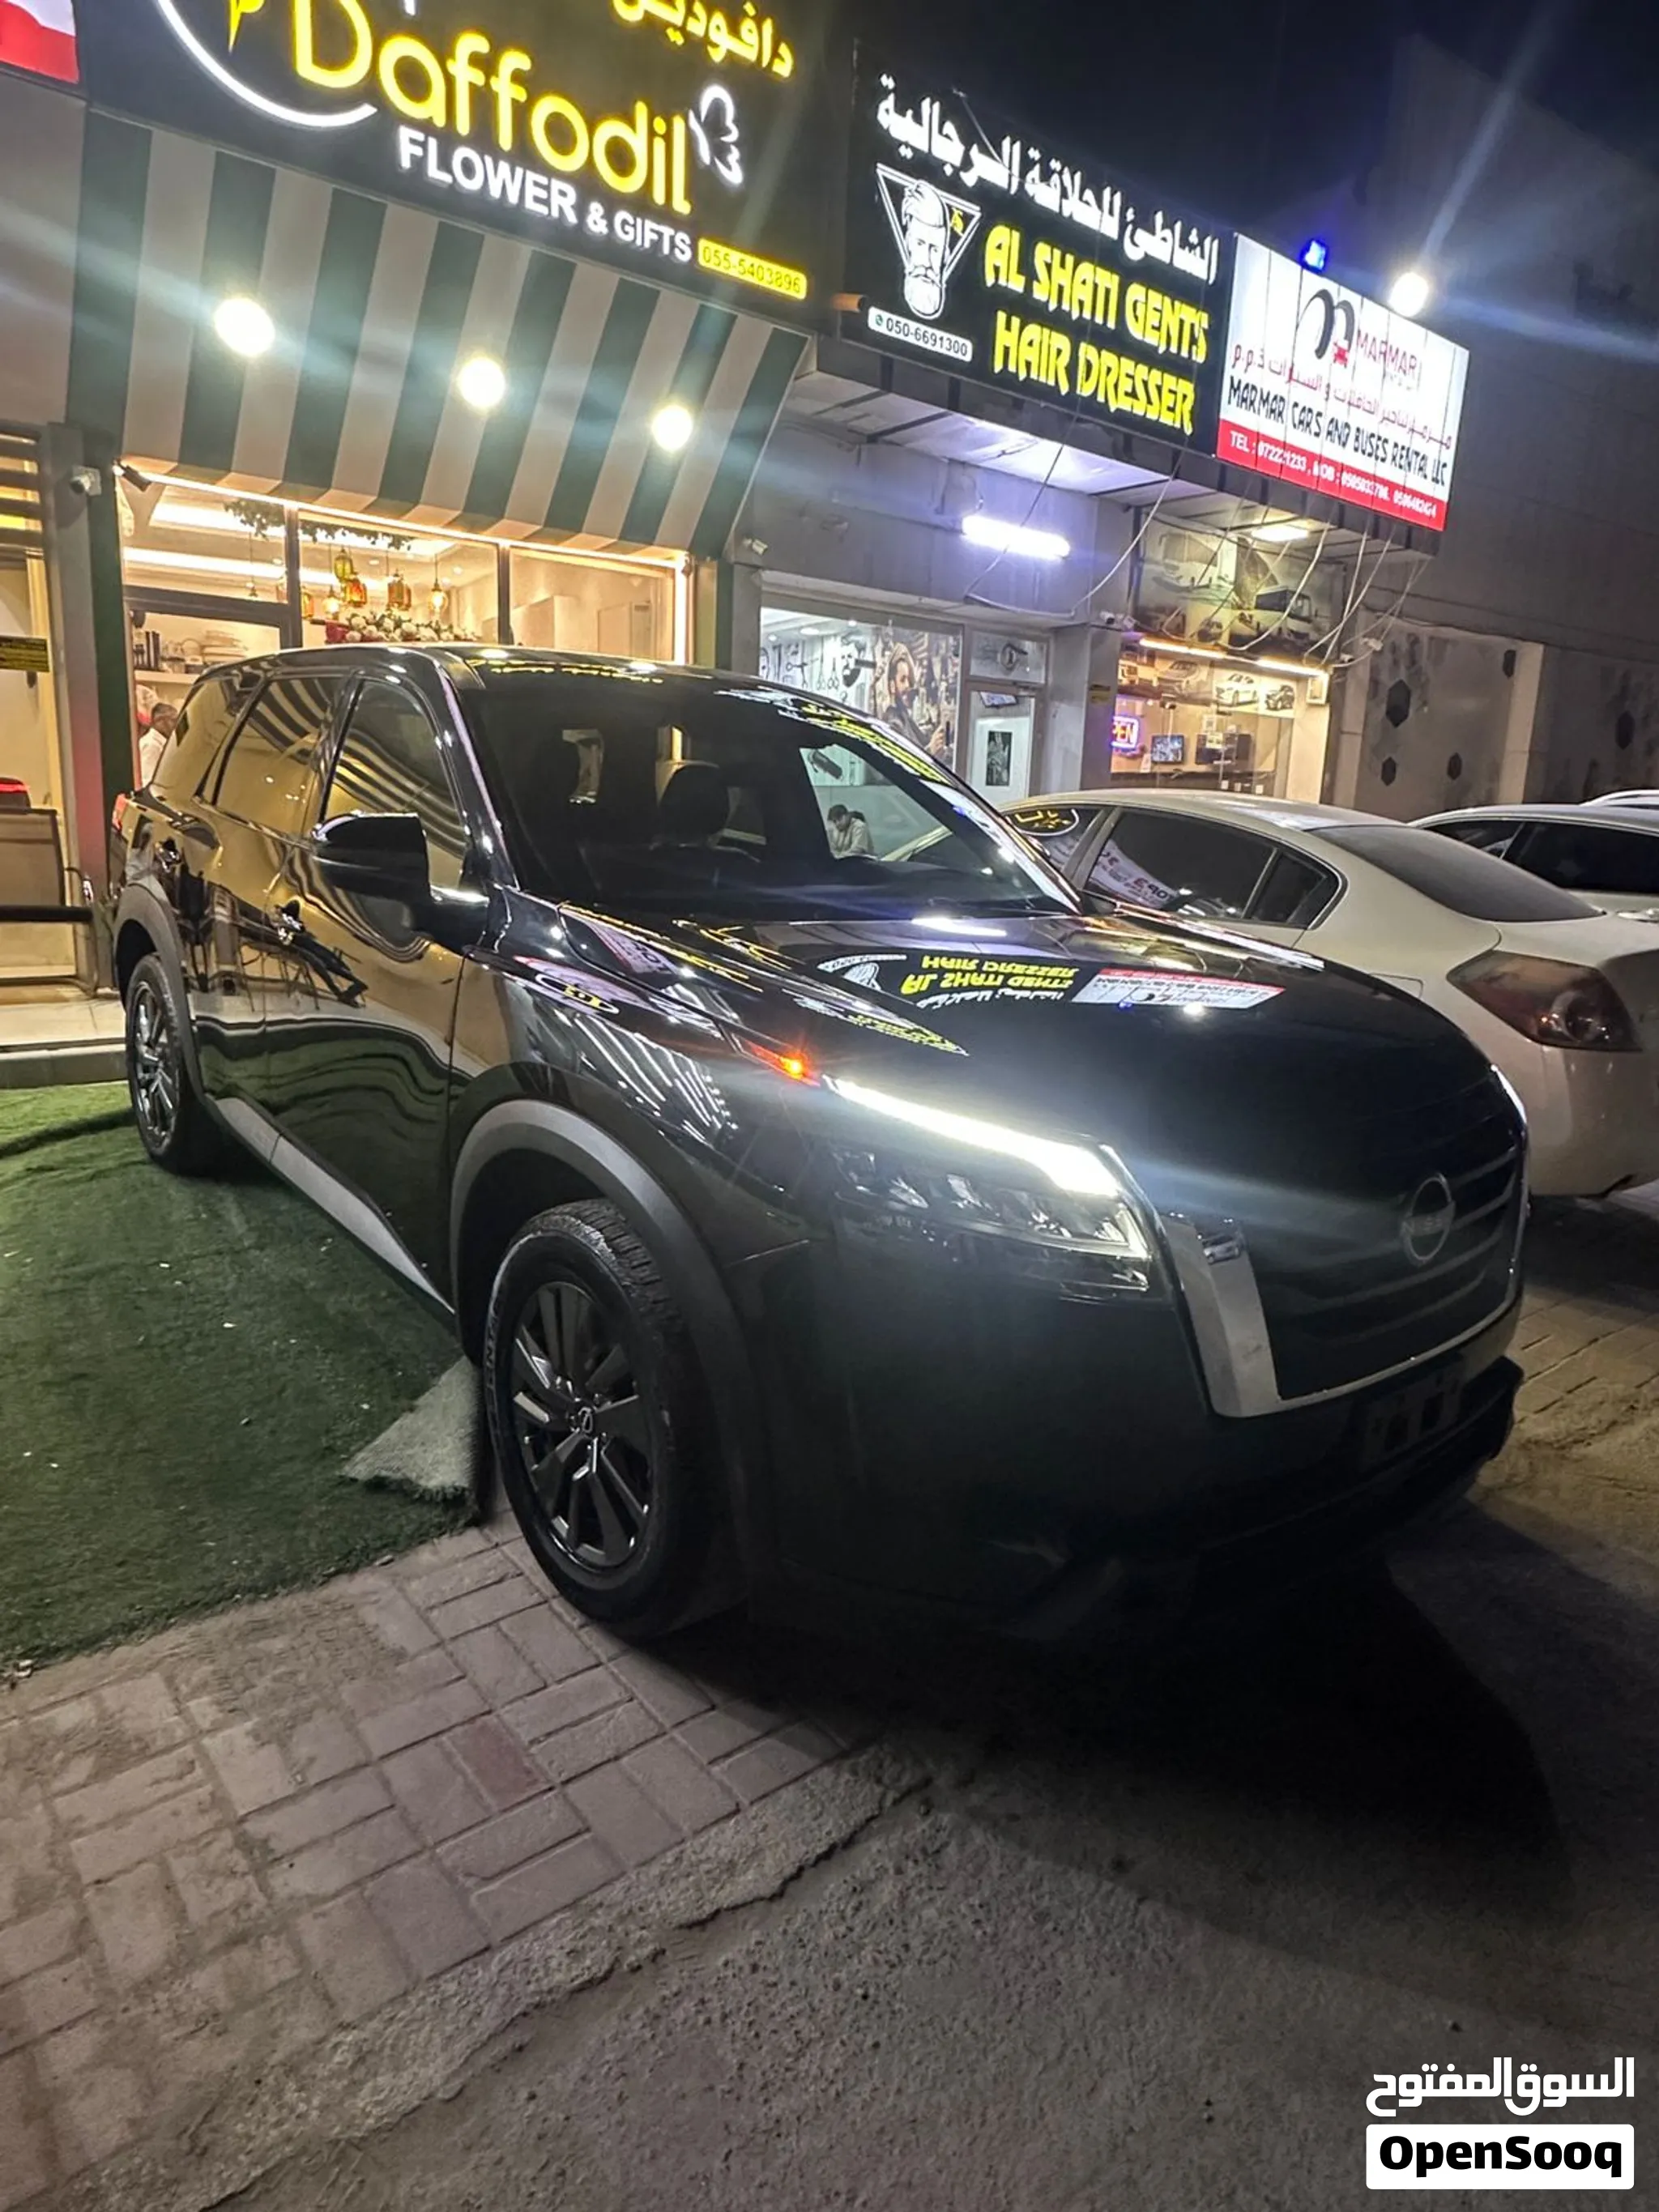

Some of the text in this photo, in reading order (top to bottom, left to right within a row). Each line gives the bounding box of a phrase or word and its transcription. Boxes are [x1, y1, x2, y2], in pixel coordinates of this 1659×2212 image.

[293, 0, 692, 215] Daffodil
[399, 126, 693, 262] FLOWER & GIFTS
[876, 74, 1219, 285] الشاطئ للحلاقة الرجالية
[702, 245, 801, 294] 055-5403896
[984, 225, 1209, 363] AL SHATI GENTS
[886, 318, 968, 356] 050-6691300
[994, 310, 1195, 435] HAIR DRESSER
[1356, 330, 1418, 379] MARMAR
[1227, 375, 1285, 424] MARMAR
[1291, 402, 1323, 437] CARS
[1325, 417, 1351, 447] AND
[1354, 427, 1389, 462] BUSES
[1391, 441, 1427, 479] RENTAL
[1230, 431, 1250, 453] TEL
